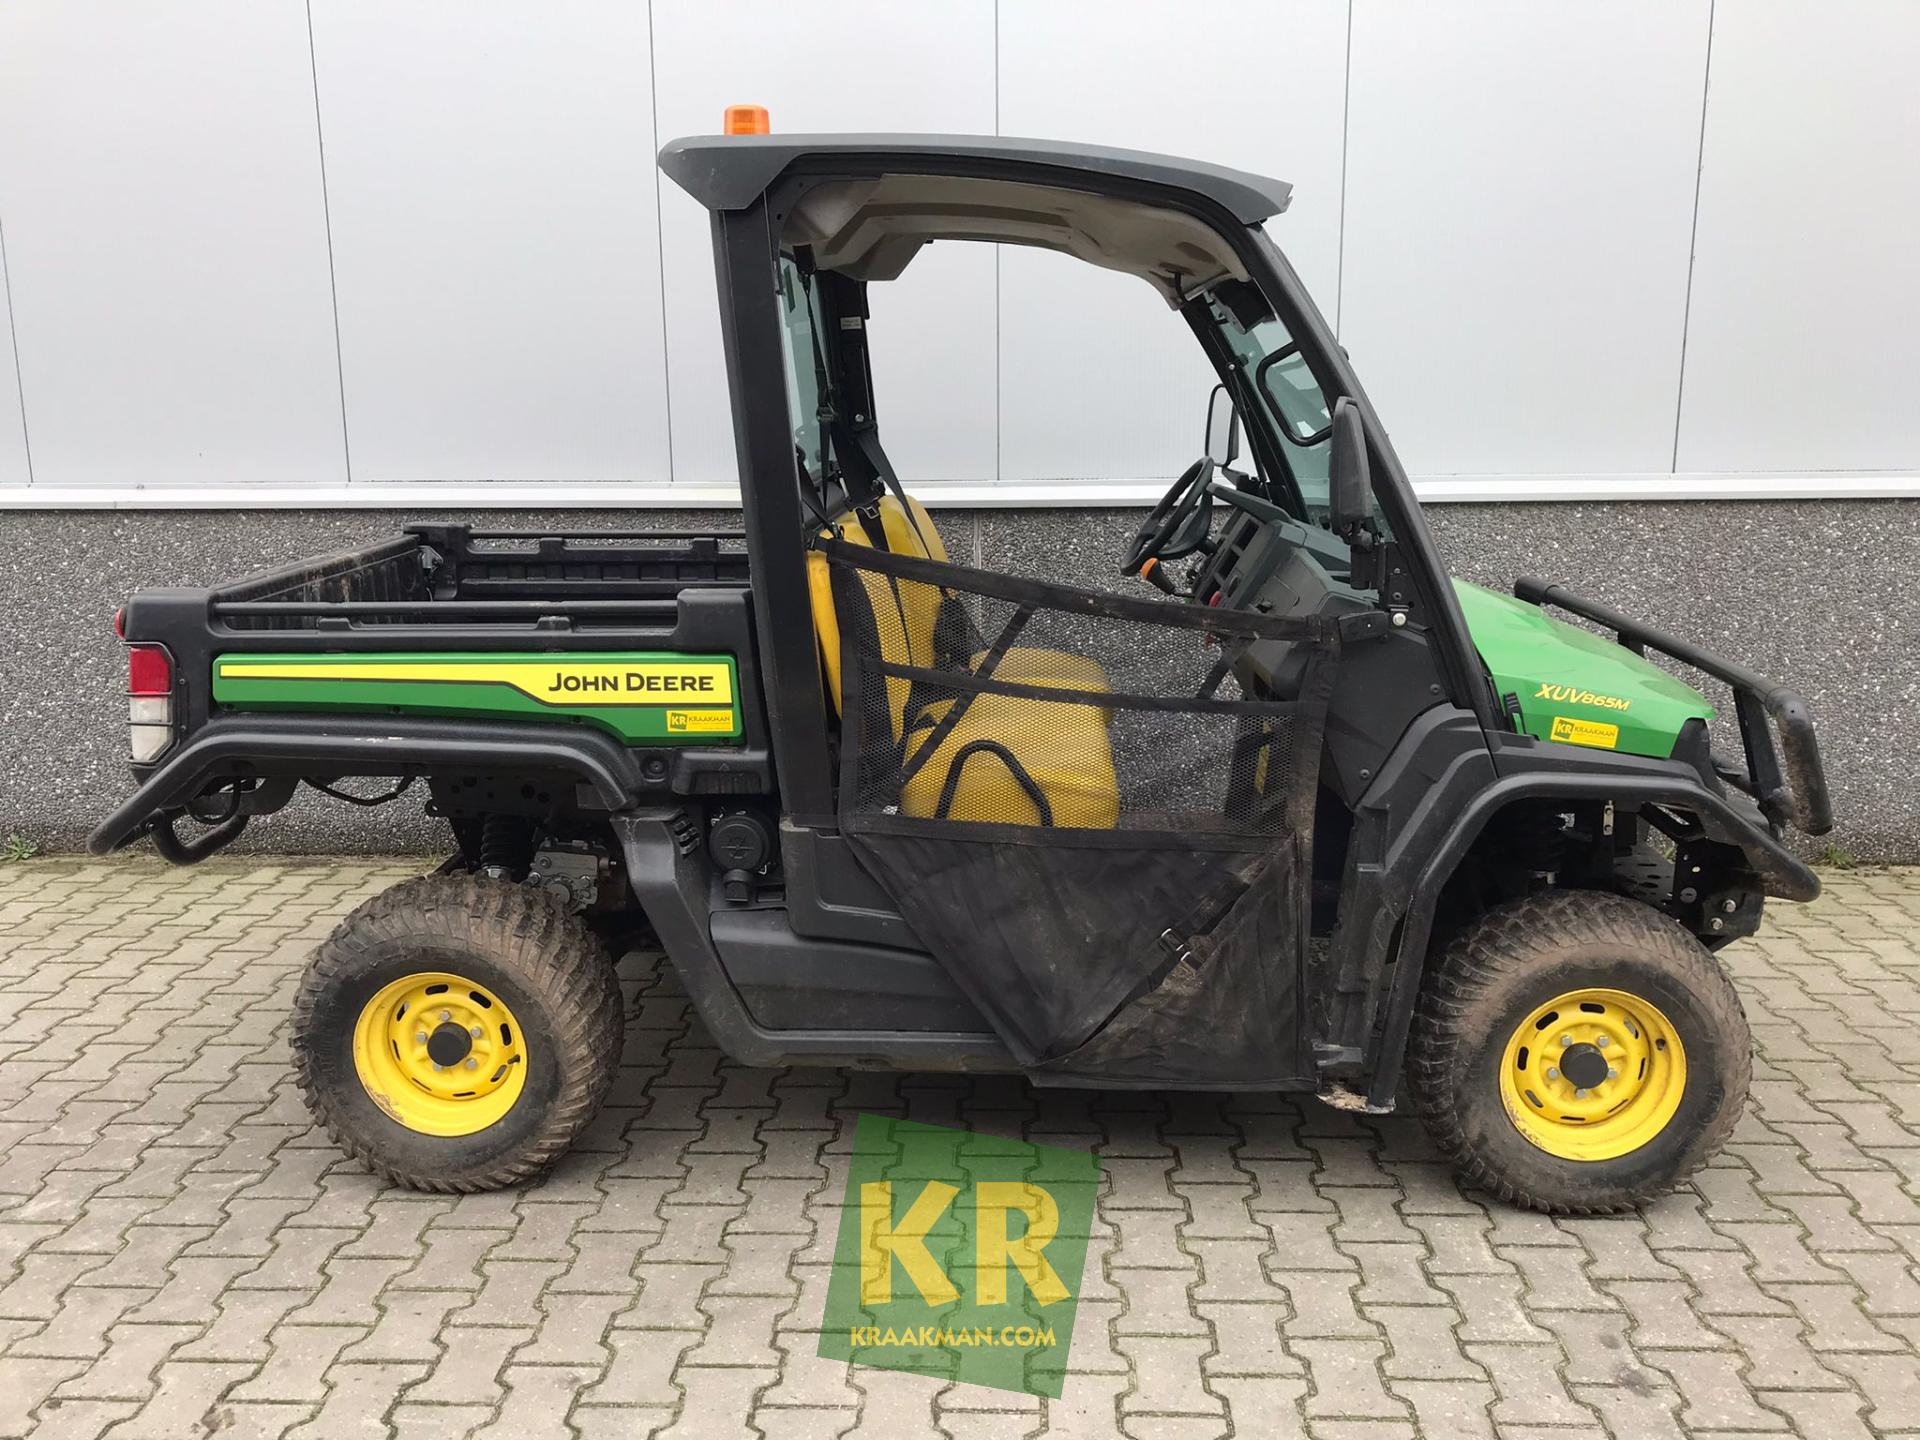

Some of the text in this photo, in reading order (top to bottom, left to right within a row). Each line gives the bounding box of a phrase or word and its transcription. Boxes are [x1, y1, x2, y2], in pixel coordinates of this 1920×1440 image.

[548, 672, 714, 692] JOHN DEERE
[1534, 683, 1632, 711] XUV865M
[672, 715, 686, 726] KR
[1556, 723, 1615, 738] KR KRAAKMAN
